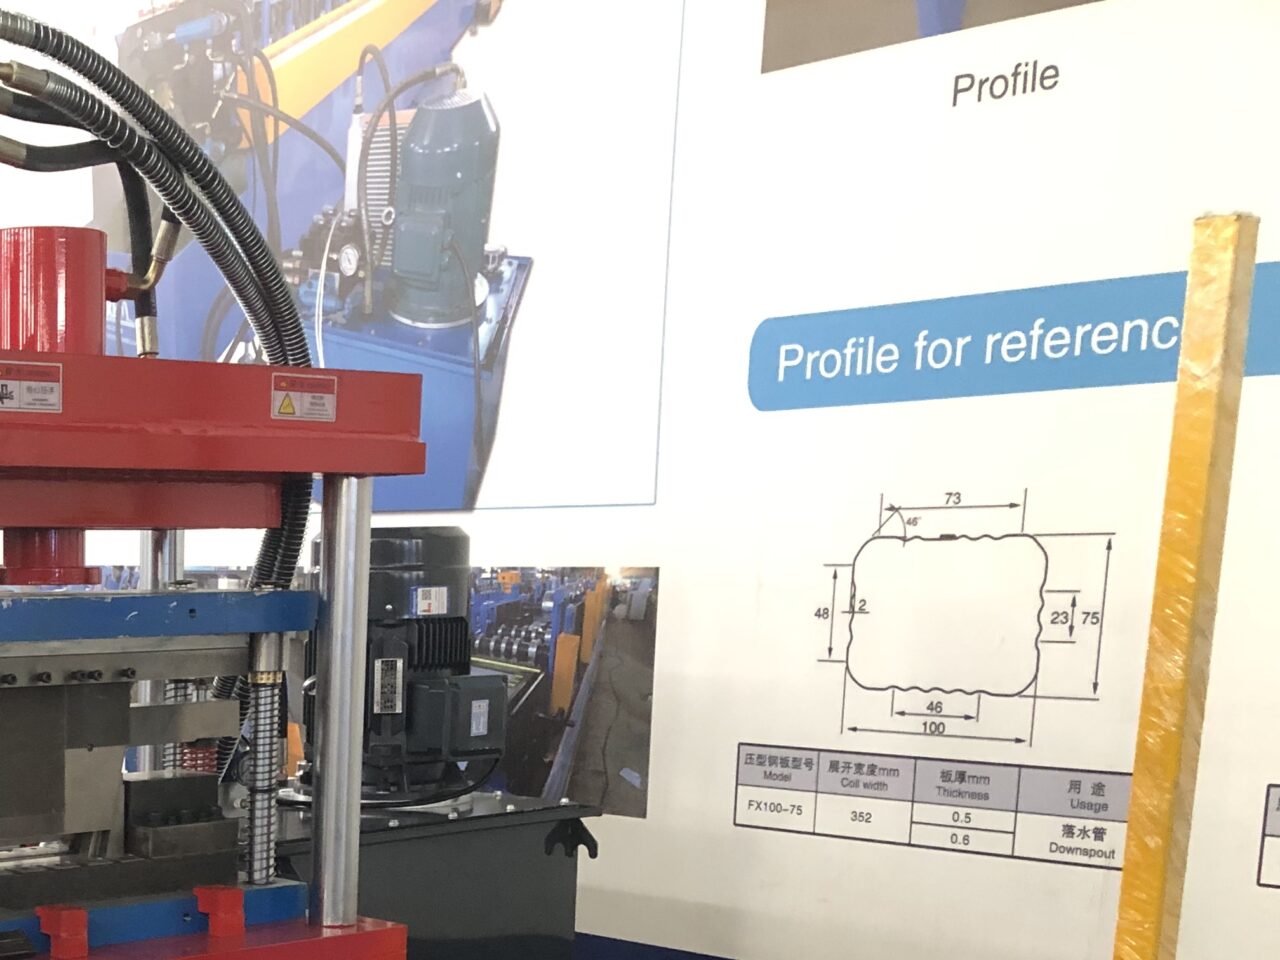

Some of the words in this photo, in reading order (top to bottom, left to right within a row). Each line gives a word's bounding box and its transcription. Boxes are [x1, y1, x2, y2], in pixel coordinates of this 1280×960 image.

[952, 60, 1060, 107] Profile
[777, 335, 900, 382] Profile
[914, 329, 972, 371] for
[985, 314, 1180, 365] referenc
[945, 491, 961, 505] 73
[858, 599, 867, 611] 2
[814, 607, 829, 620] 48
[1050, 611, 1069, 625] 23
[1082, 611, 1100, 625] 75
[926, 701, 943, 714] 46
[922, 721, 945, 734] 100
[763, 770, 792, 782] Model
[841, 777, 859, 788] Coil
[863, 781, 888, 791] width
[936, 786, 989, 800] Thickness
[748, 800, 803, 816] FX100-75
[1070, 799, 1108, 813] Usage
[850, 811, 872, 823] 352
[952, 811, 972, 824] 0.5
[950, 833, 970, 845] 0.6
[1062, 823, 1107, 842] 落水管
[1049, 842, 1116, 859] Downspout
